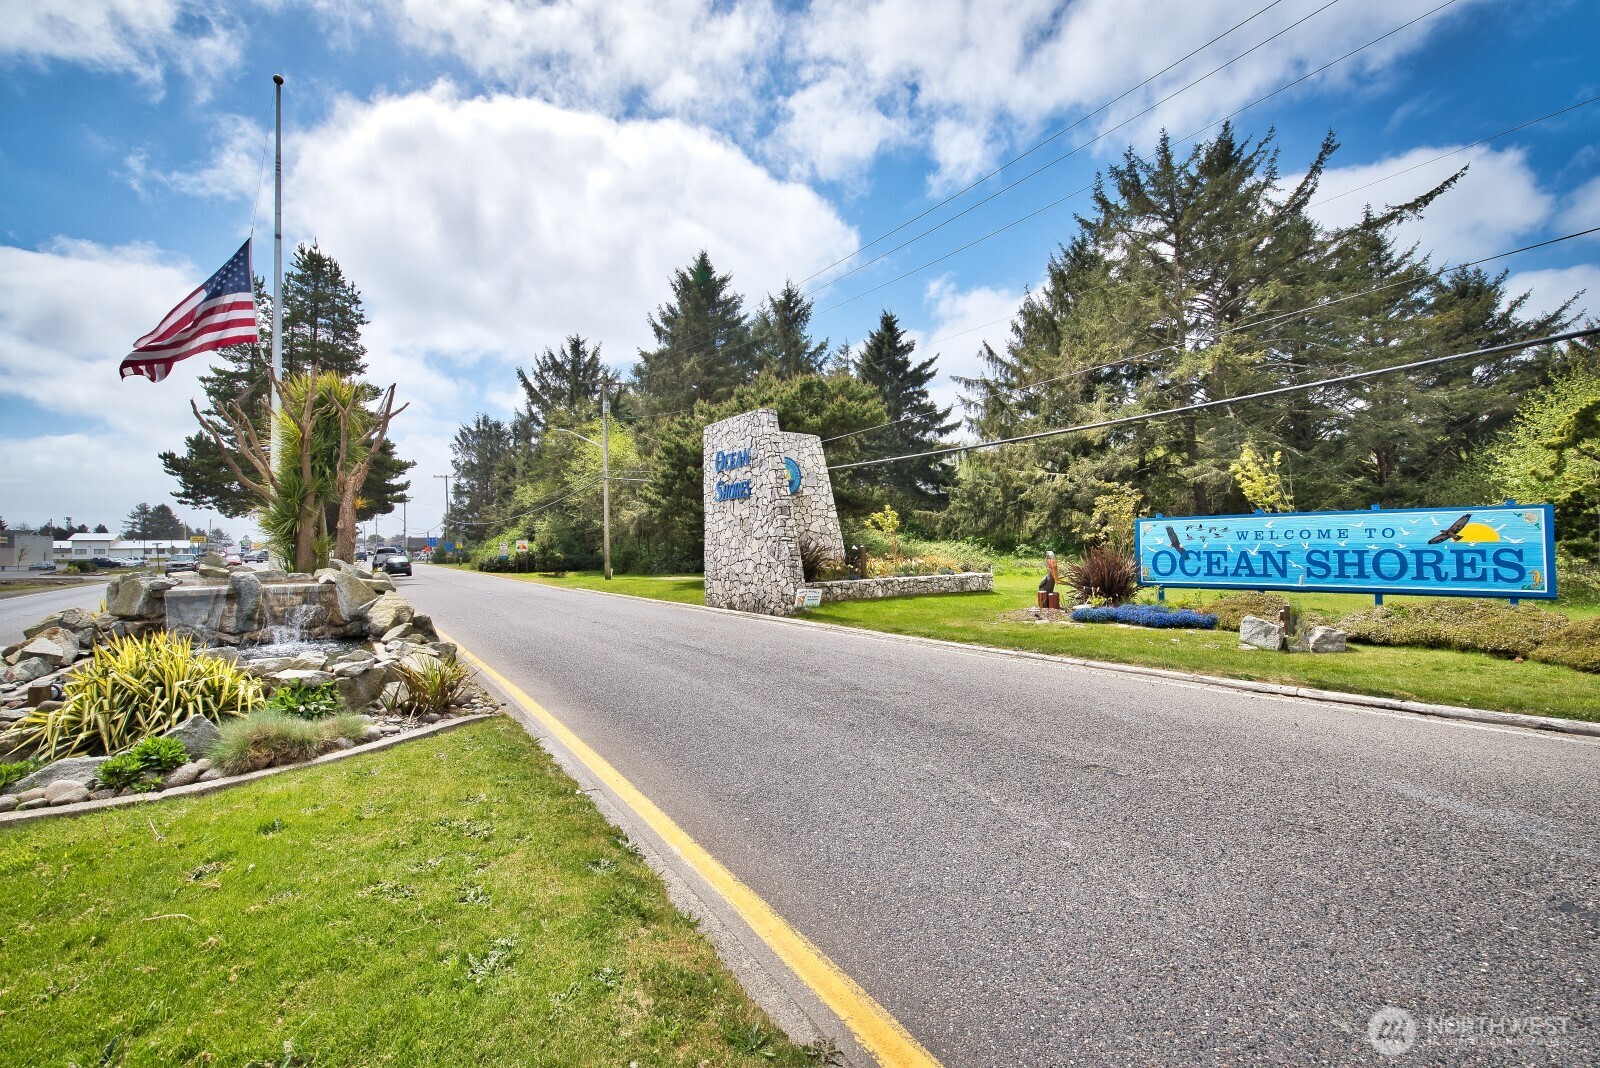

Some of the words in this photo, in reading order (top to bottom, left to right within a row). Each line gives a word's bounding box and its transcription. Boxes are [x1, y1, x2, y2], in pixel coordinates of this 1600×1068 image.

[1236, 528, 1349, 541] WELCOME
[1365, 527, 1396, 539] TO
[1152, 550, 1290, 578] OCEAN
[1305, 548, 1527, 583] SHORES
